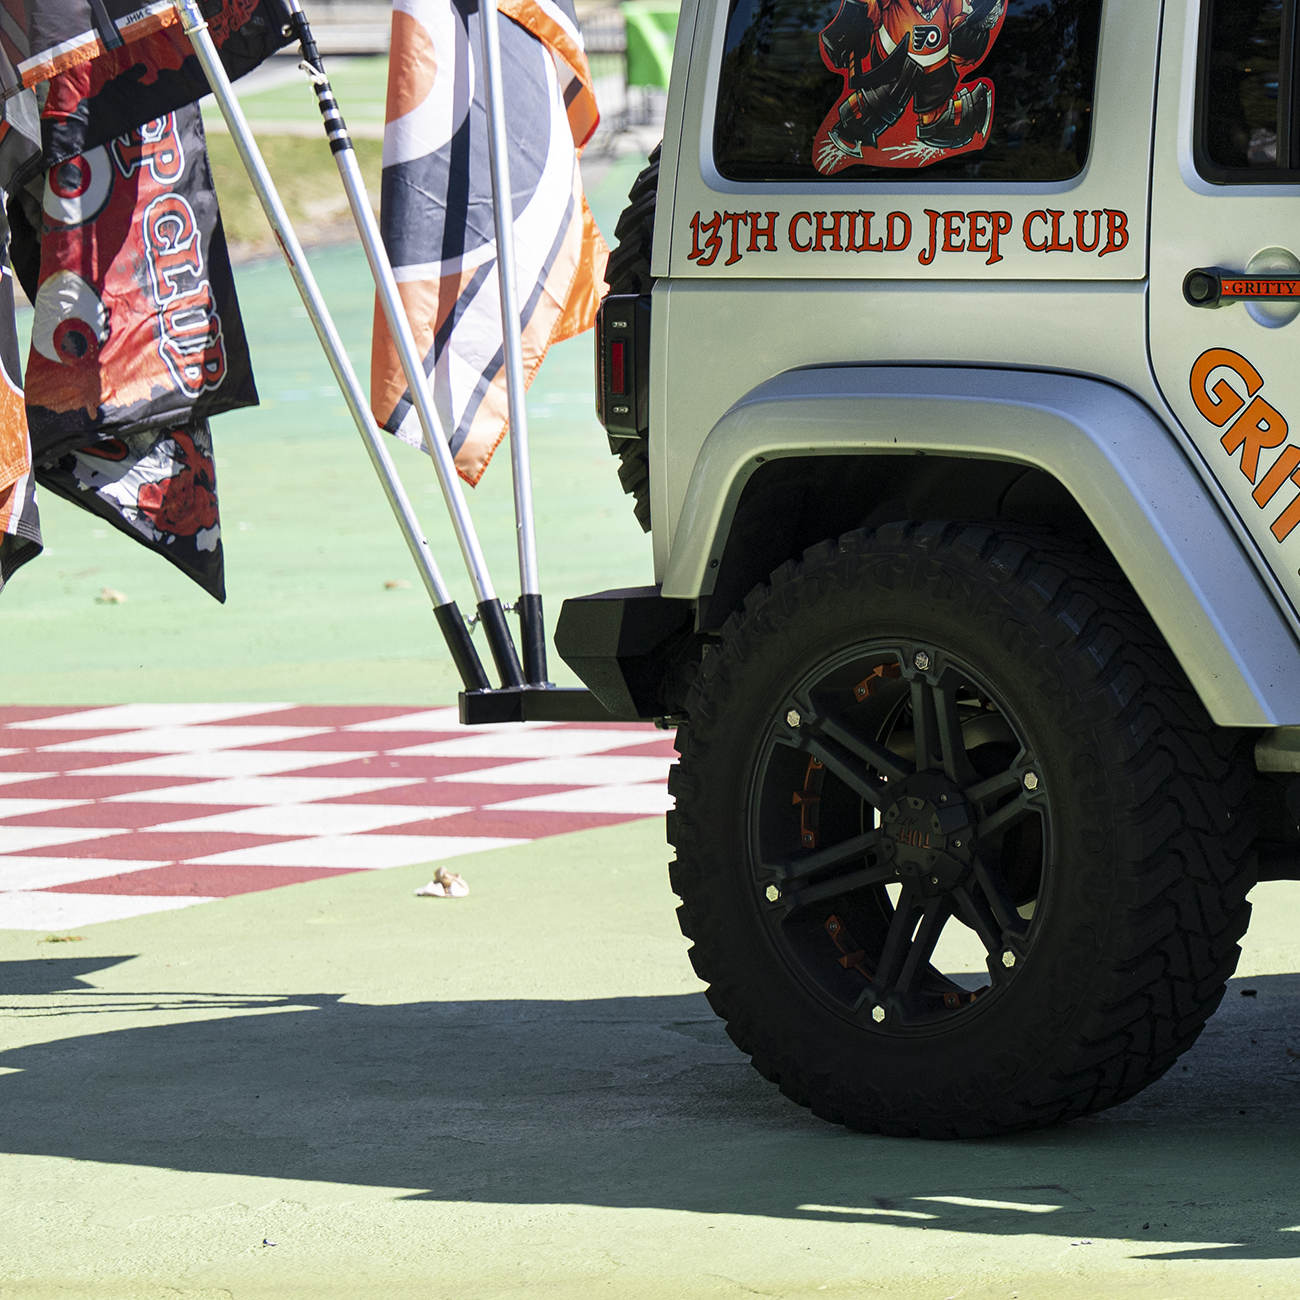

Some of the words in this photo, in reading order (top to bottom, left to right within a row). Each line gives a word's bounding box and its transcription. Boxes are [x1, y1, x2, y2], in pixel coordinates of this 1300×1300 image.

[687, 210, 780, 267] 13TH
[788, 209, 913, 255] CHILD
[917, 208, 1013, 267] JEEP
[1021, 208, 1131, 259] CLUB
[143, 192, 228, 399] CLUB
[1232, 282, 1297, 294] GRITTY
